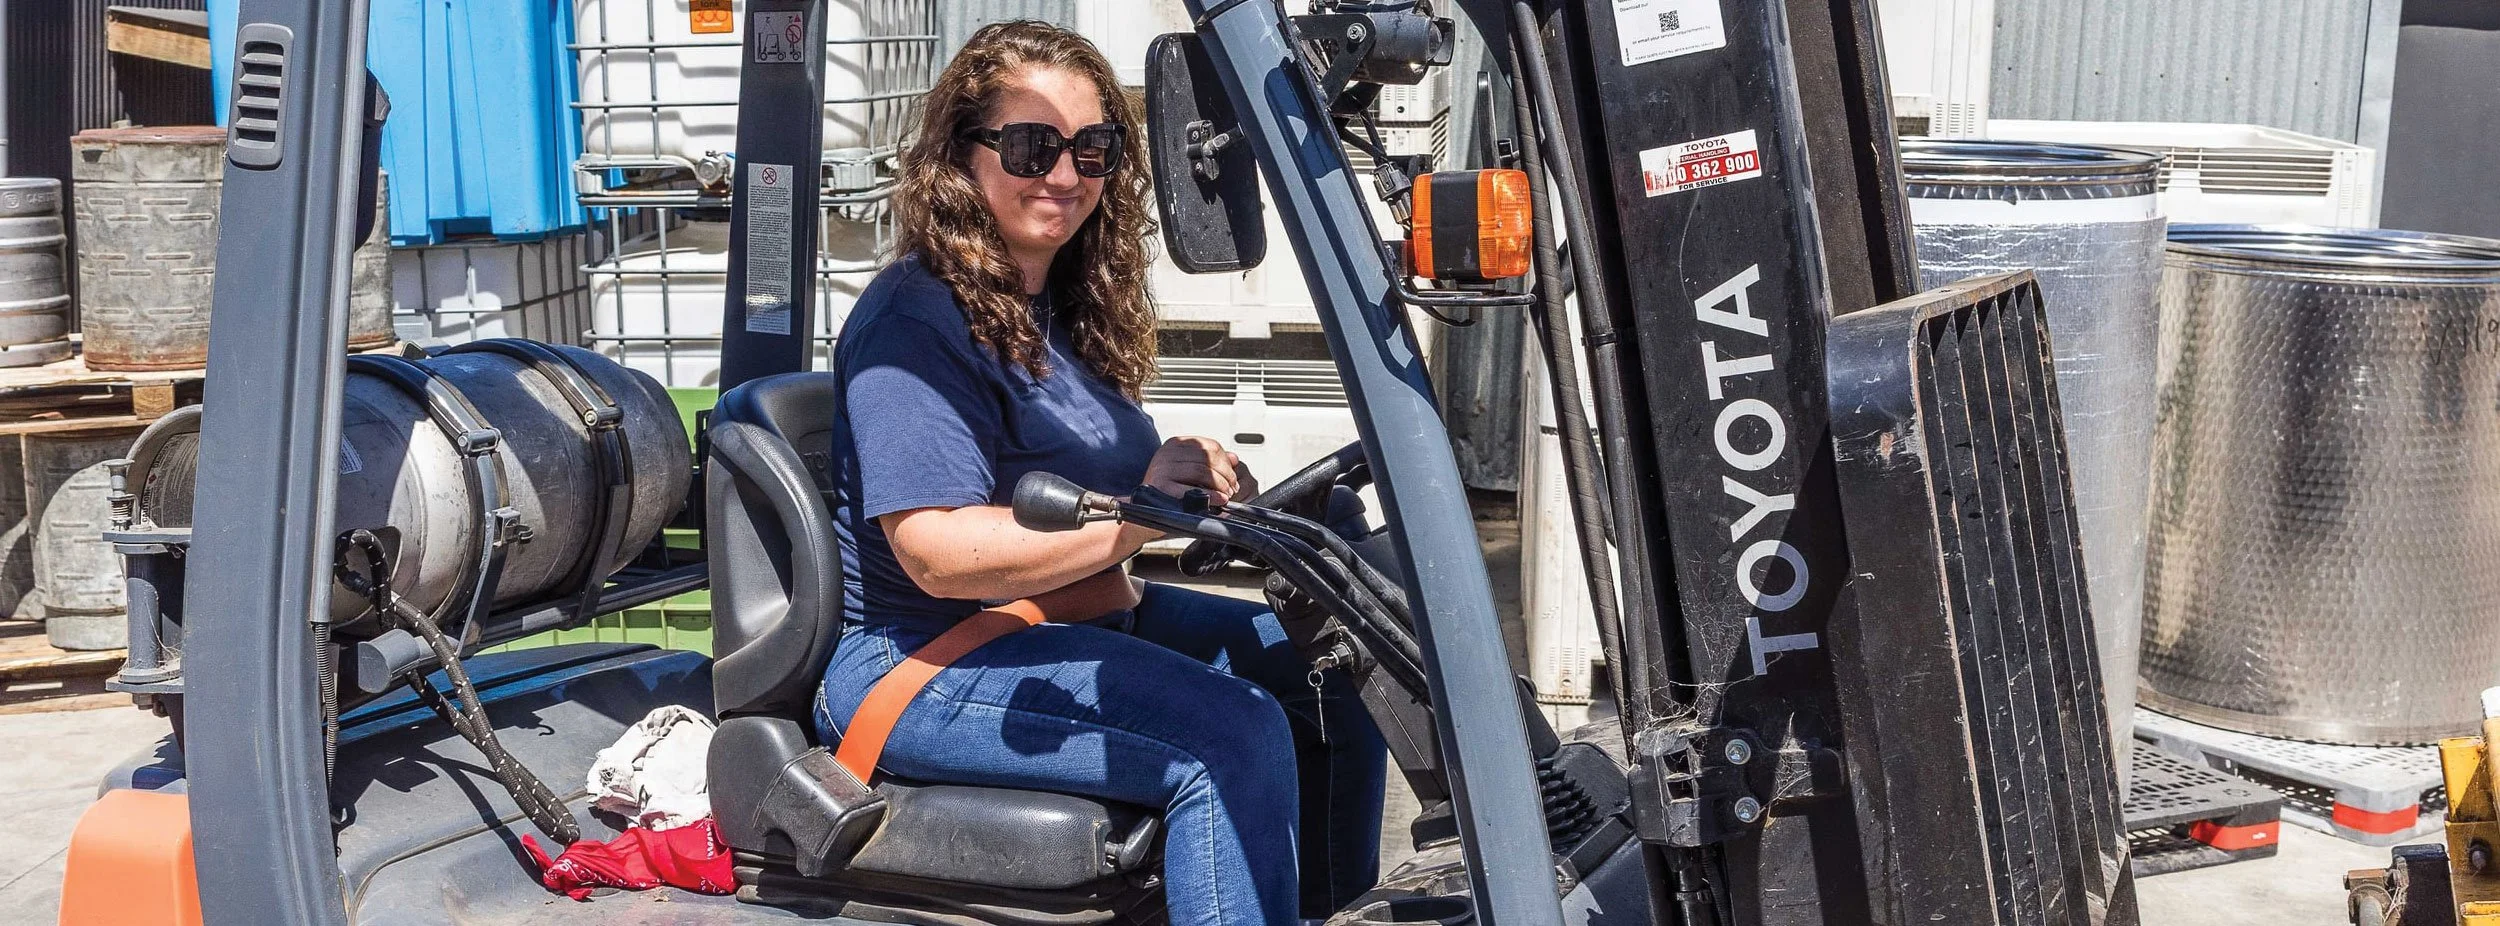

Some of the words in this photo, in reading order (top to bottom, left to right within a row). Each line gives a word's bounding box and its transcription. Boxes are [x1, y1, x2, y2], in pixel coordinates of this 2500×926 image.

[1685, 138, 1727, 152] TOYOTA
[1692, 160, 1720, 179] 362
[1725, 154, 1754, 172] 900
[1679, 181, 1694, 191] FOR
[1695, 176, 1728, 188] SERVICE
[1695, 263, 1819, 675] TOYOTA
